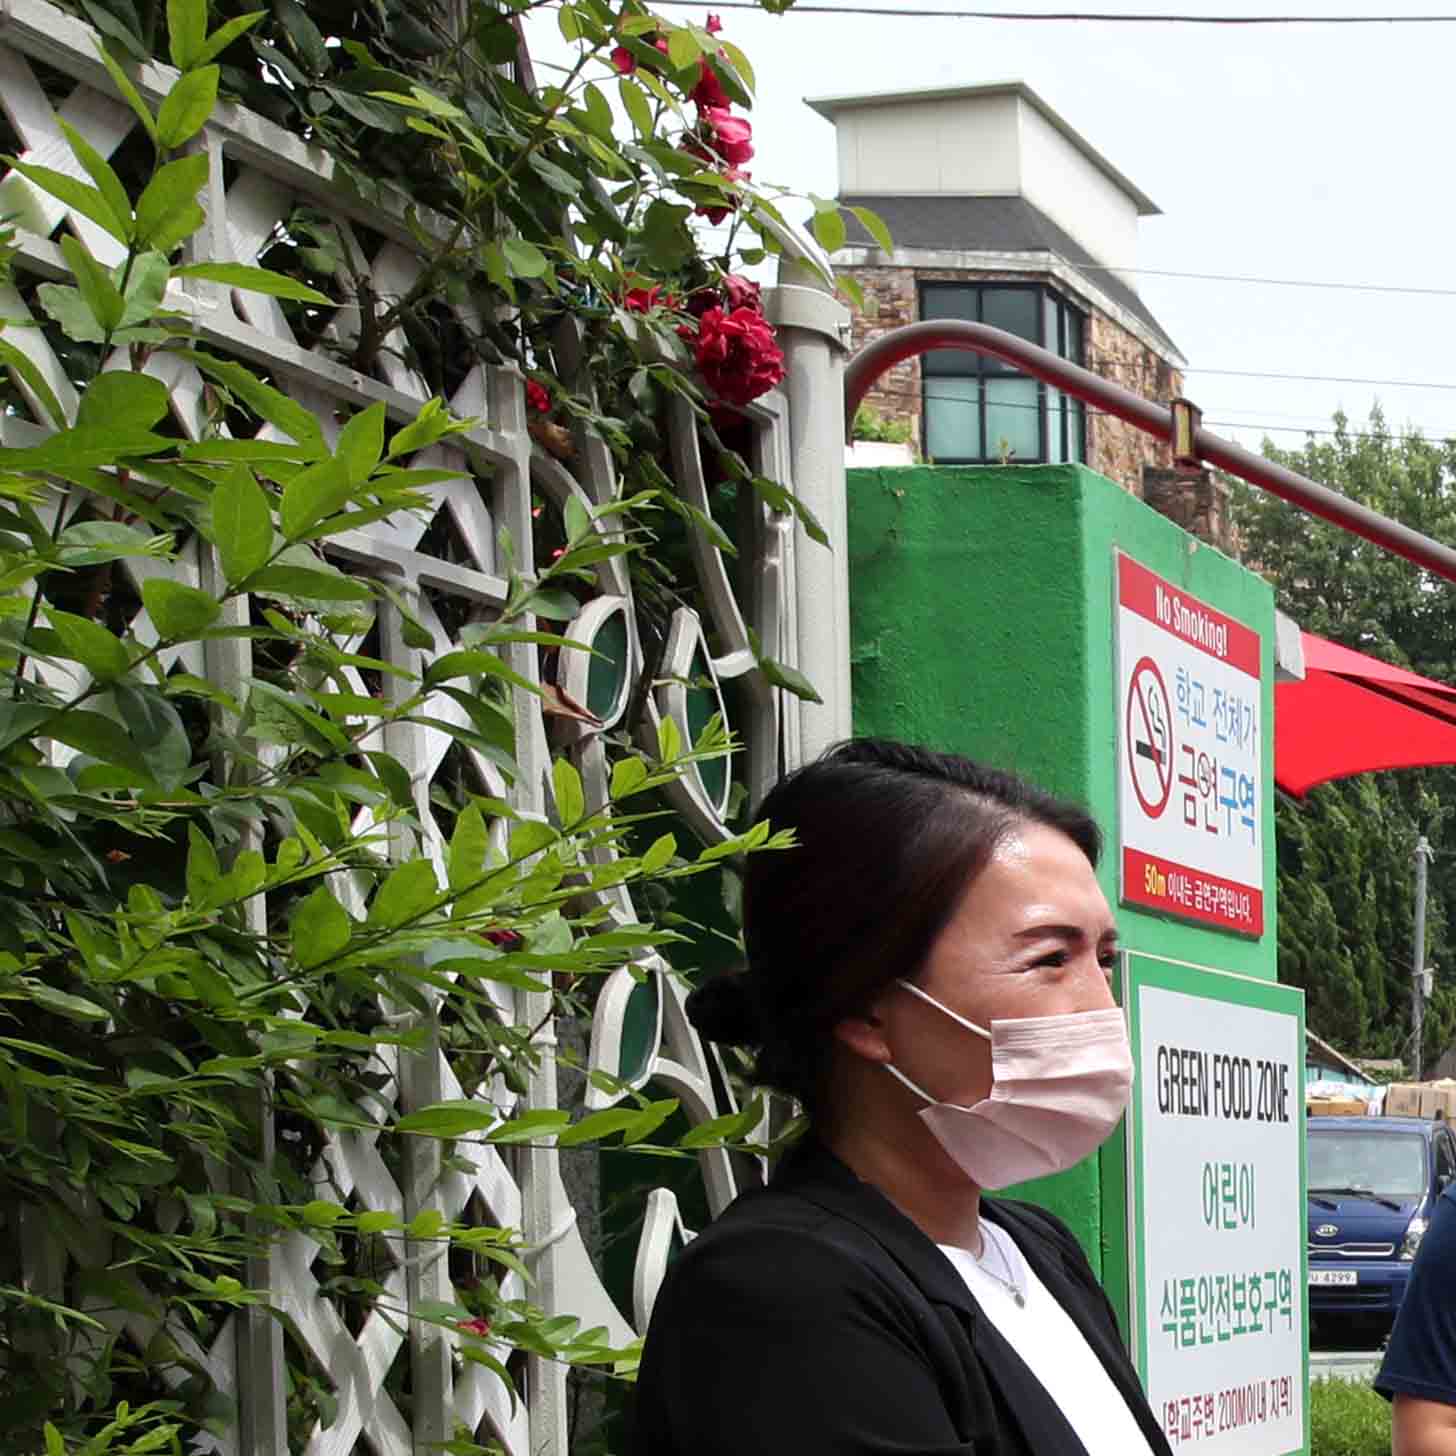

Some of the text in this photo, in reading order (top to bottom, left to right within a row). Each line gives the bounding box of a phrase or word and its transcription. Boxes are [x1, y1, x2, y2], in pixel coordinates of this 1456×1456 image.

[1155, 584, 1228, 657] No Smoking!
[1175, 666, 1257, 757] 학교 전체가
[1179, 743, 1257, 847] 금연구역
[1144, 863, 1166, 897] 50m
[1168, 872, 1193, 908] 이내는
[1157, 1044, 1289, 1124] GREEN FOOD ZONE
[1203, 1162, 1256, 1230] 어린이
[1160, 1268, 1293, 1350] 식품안전보호구역
[1163, 1392, 1214, 1446] (학교주변
[1270, 1375, 1293, 1419] 지역)
